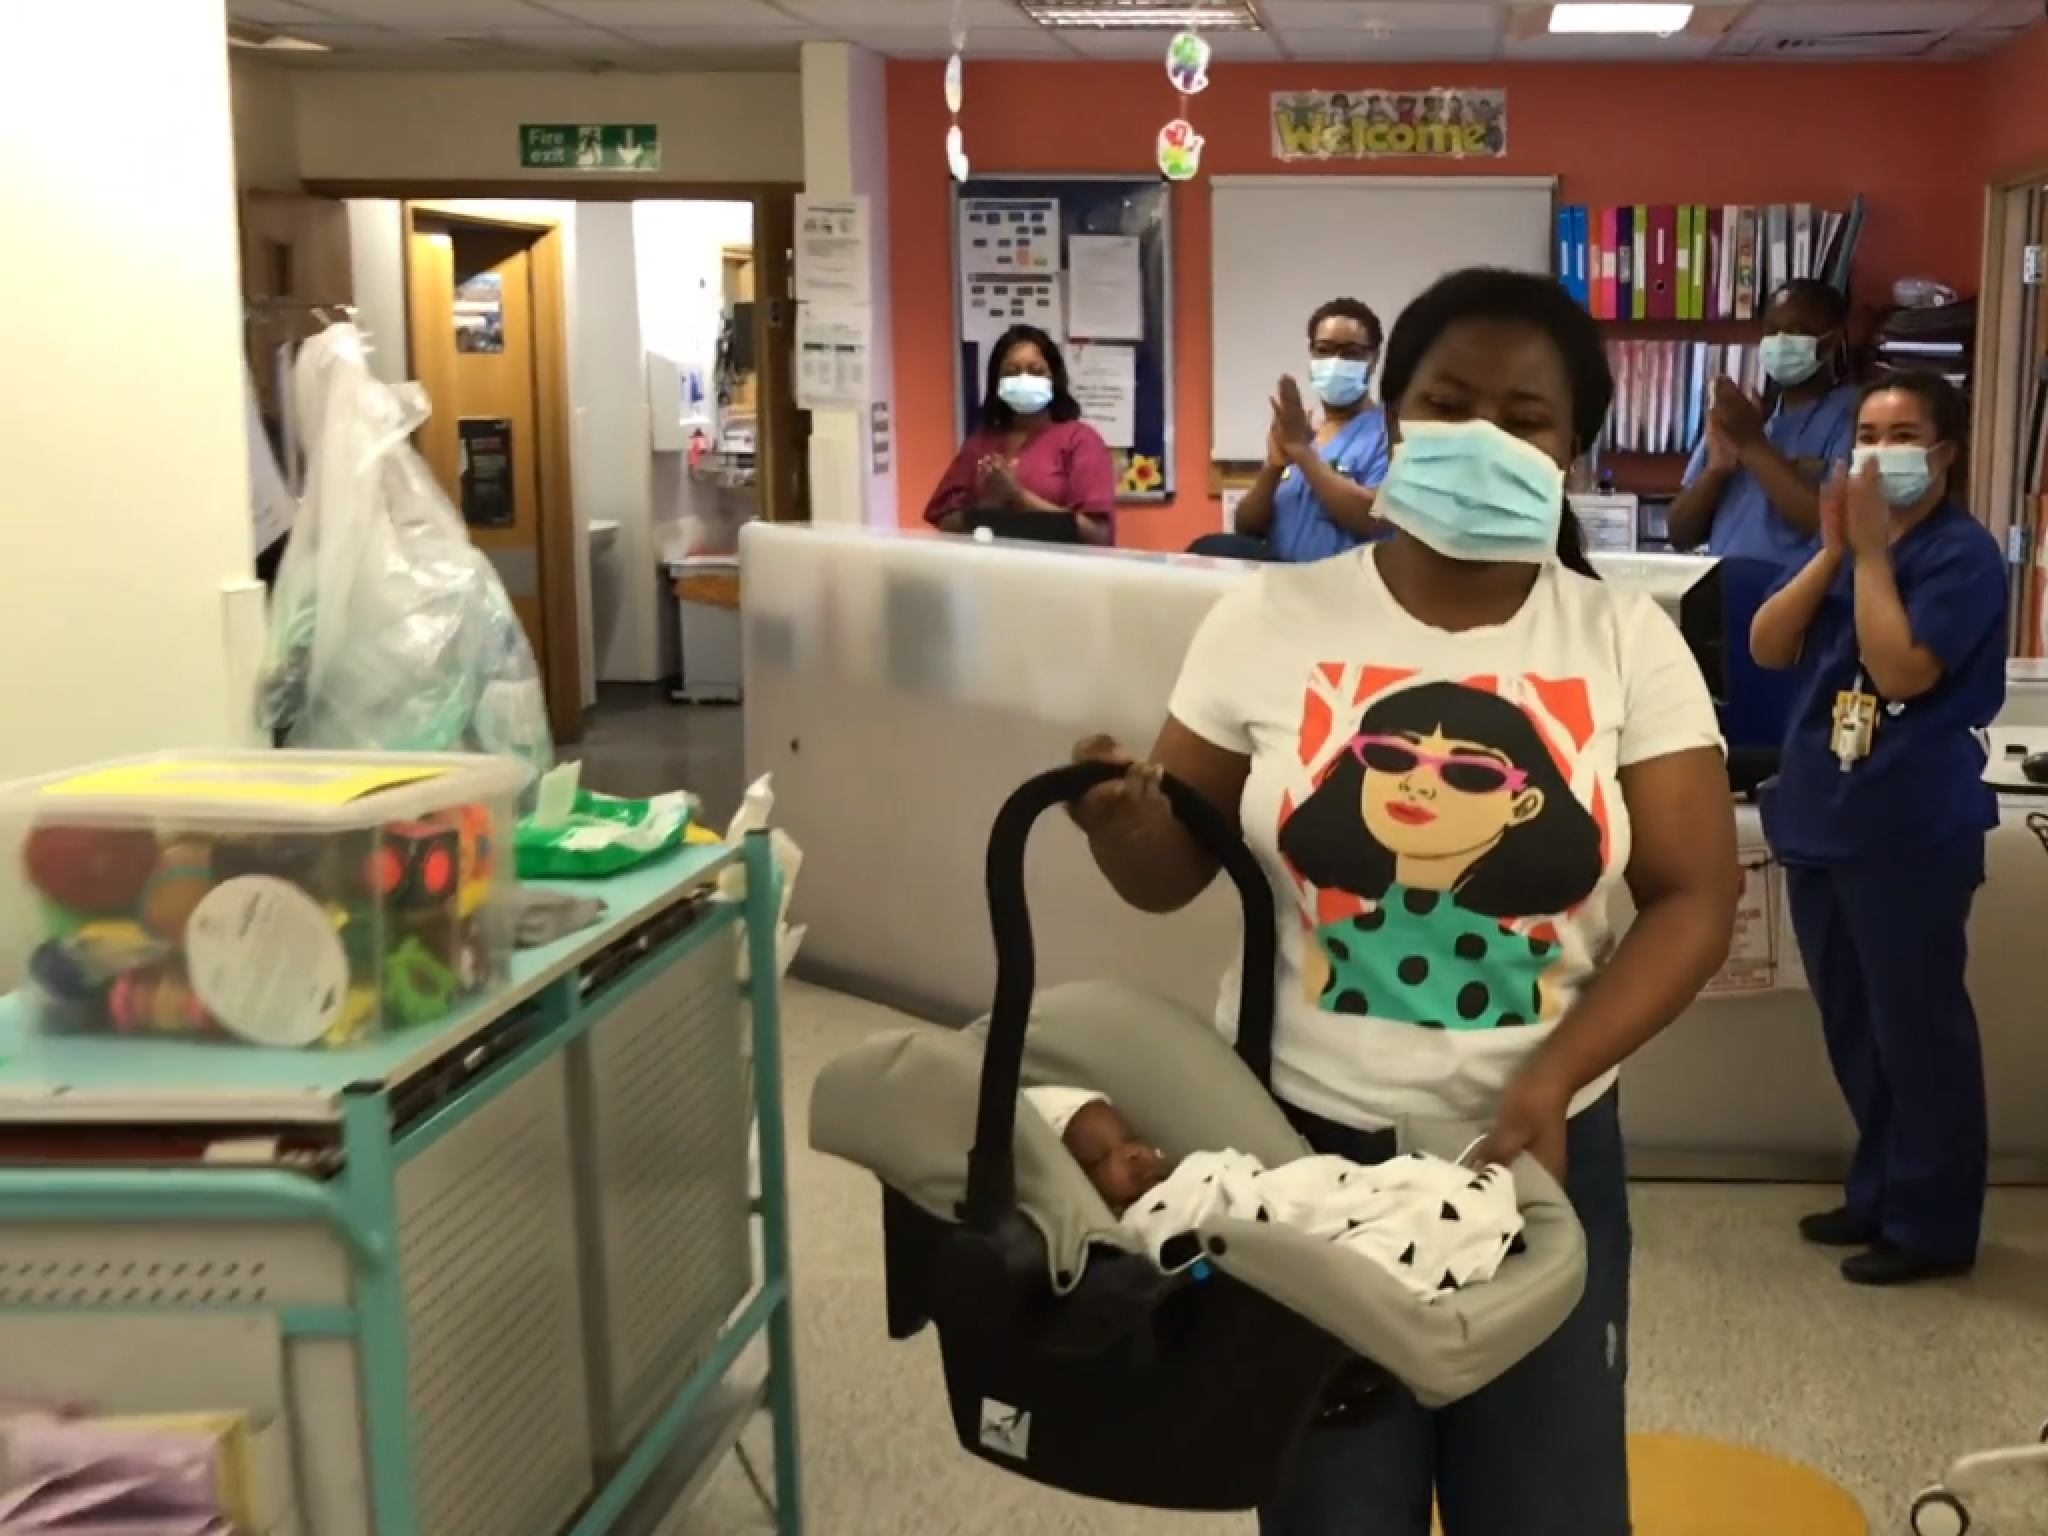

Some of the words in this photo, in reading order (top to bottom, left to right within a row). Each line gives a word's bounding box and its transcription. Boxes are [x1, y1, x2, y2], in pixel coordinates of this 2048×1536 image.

[529, 128, 564, 145] Fire
[1275, 110, 1487, 153] Welcome
[529, 147, 564, 163] exit
